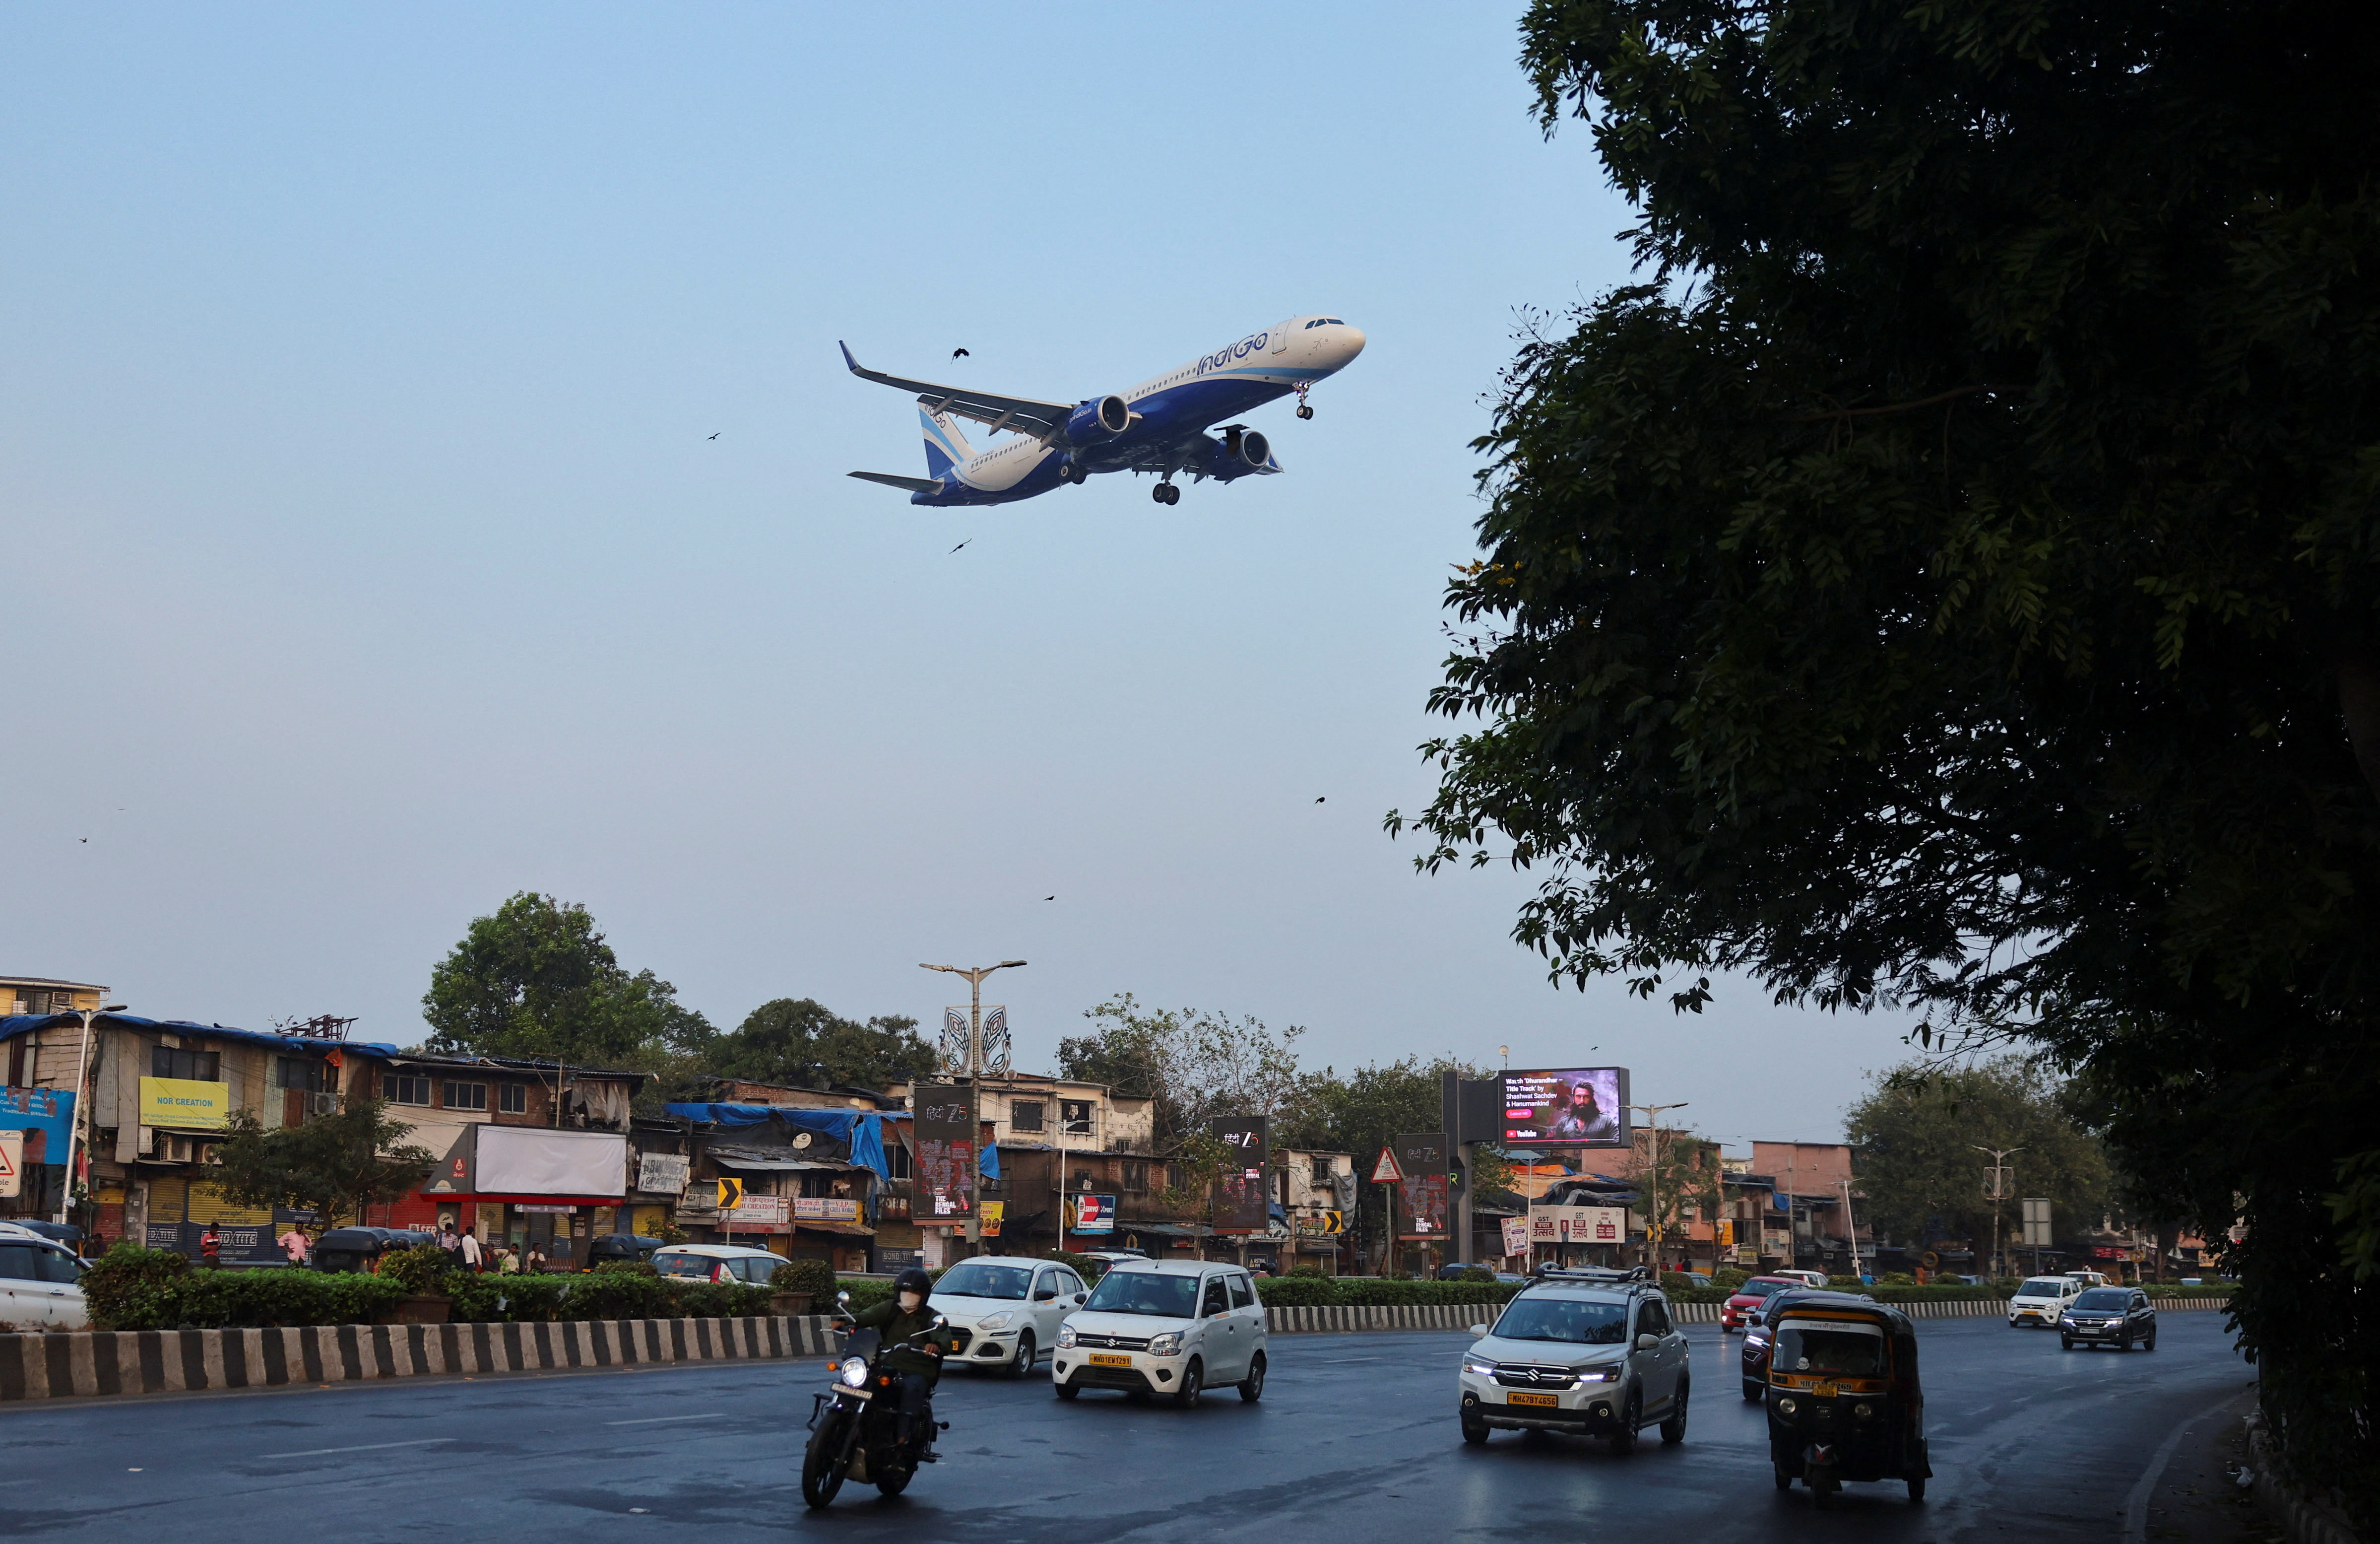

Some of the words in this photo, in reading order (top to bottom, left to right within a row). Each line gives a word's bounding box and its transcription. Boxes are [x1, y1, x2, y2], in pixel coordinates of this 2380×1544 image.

[1197, 333, 1268, 376] IndiGo
[176, 1098, 213, 1107] CREATION
[1533, 1228, 1555, 1237] उत्सव
[1572, 1228, 1588, 1239] उत्सव
[883, 1252, 900, 1260] BOND
[1094, 1355, 1129, 1365] MH01EW1291
[1513, 1395, 1556, 1405] MH47BY4656
